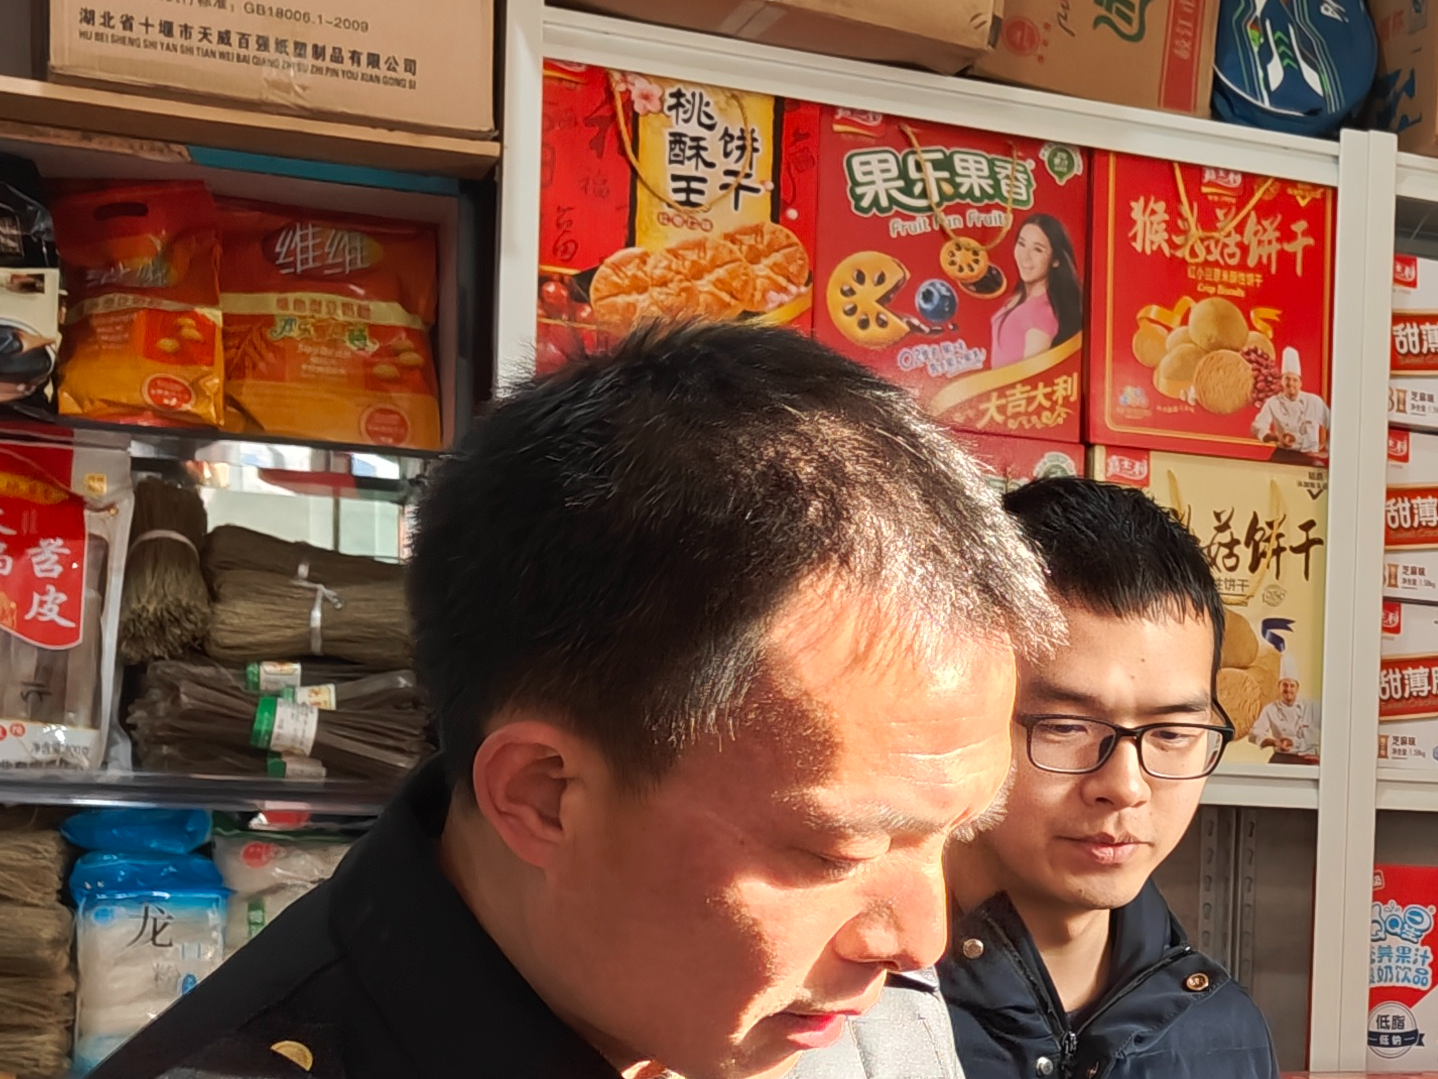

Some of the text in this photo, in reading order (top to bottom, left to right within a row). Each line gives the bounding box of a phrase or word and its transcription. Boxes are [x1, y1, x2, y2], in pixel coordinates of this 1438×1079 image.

[79, 7, 418, 77] 湖北省十堰市天威百强纸塑制品有限公司
[664, 87, 718, 210] 桃酥王
[718, 126, 762, 212] 饼干
[846, 151, 1029, 210] 果乐果香
[976, 372, 1079, 429] 大吉大利
[1186, 504, 1324, 582] 菇饼干
[1376, 1014, 1406, 1030] 低脂
